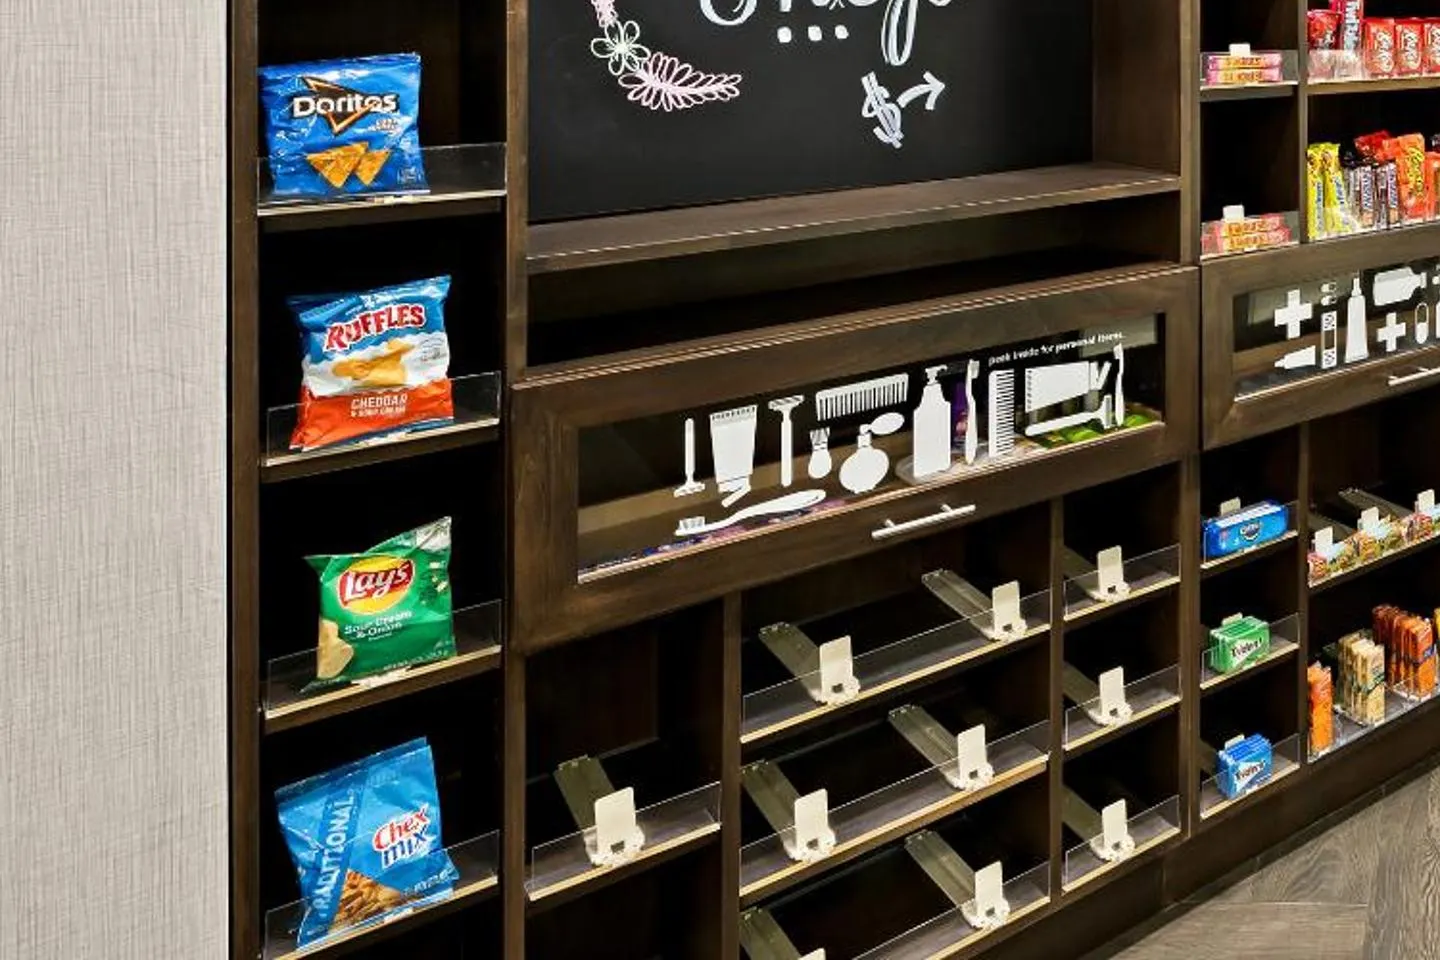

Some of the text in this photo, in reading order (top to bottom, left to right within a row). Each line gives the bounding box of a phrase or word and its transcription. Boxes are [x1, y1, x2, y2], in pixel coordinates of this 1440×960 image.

[292, 93, 400, 118] Doritos
[323, 303, 426, 352] RUFFLES
[351, 393, 408, 409] CHEDDAR
[344, 562, 411, 601] Lay's
[373, 805, 430, 851] Chex
